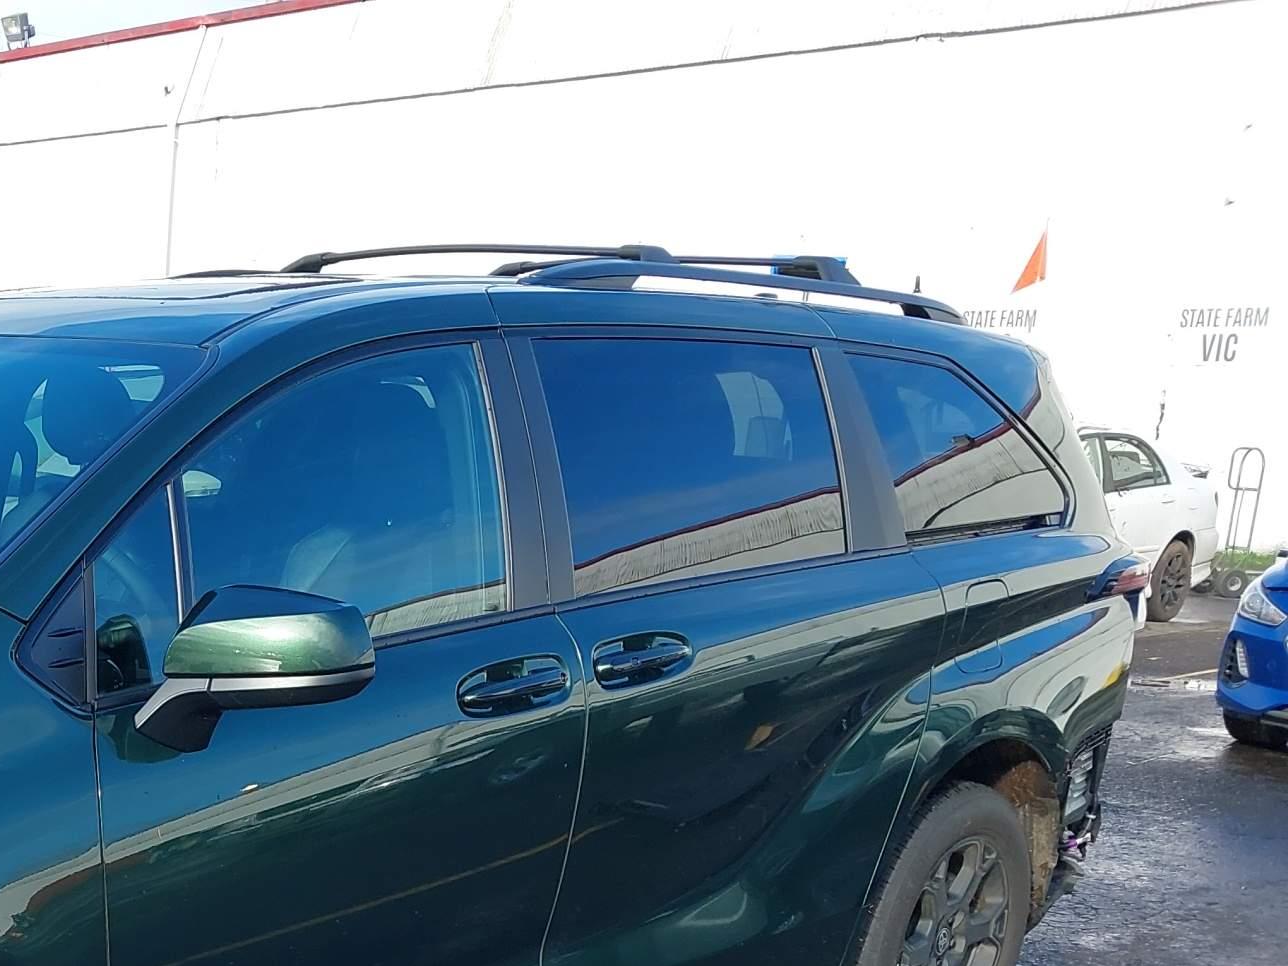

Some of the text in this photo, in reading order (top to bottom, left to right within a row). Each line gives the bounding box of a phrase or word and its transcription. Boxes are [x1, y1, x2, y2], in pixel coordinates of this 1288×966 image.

[963, 309, 1038, 330] STATE FARM
[1179, 307, 1270, 328] STATE FARM
[1201, 332, 1239, 362] VIC
